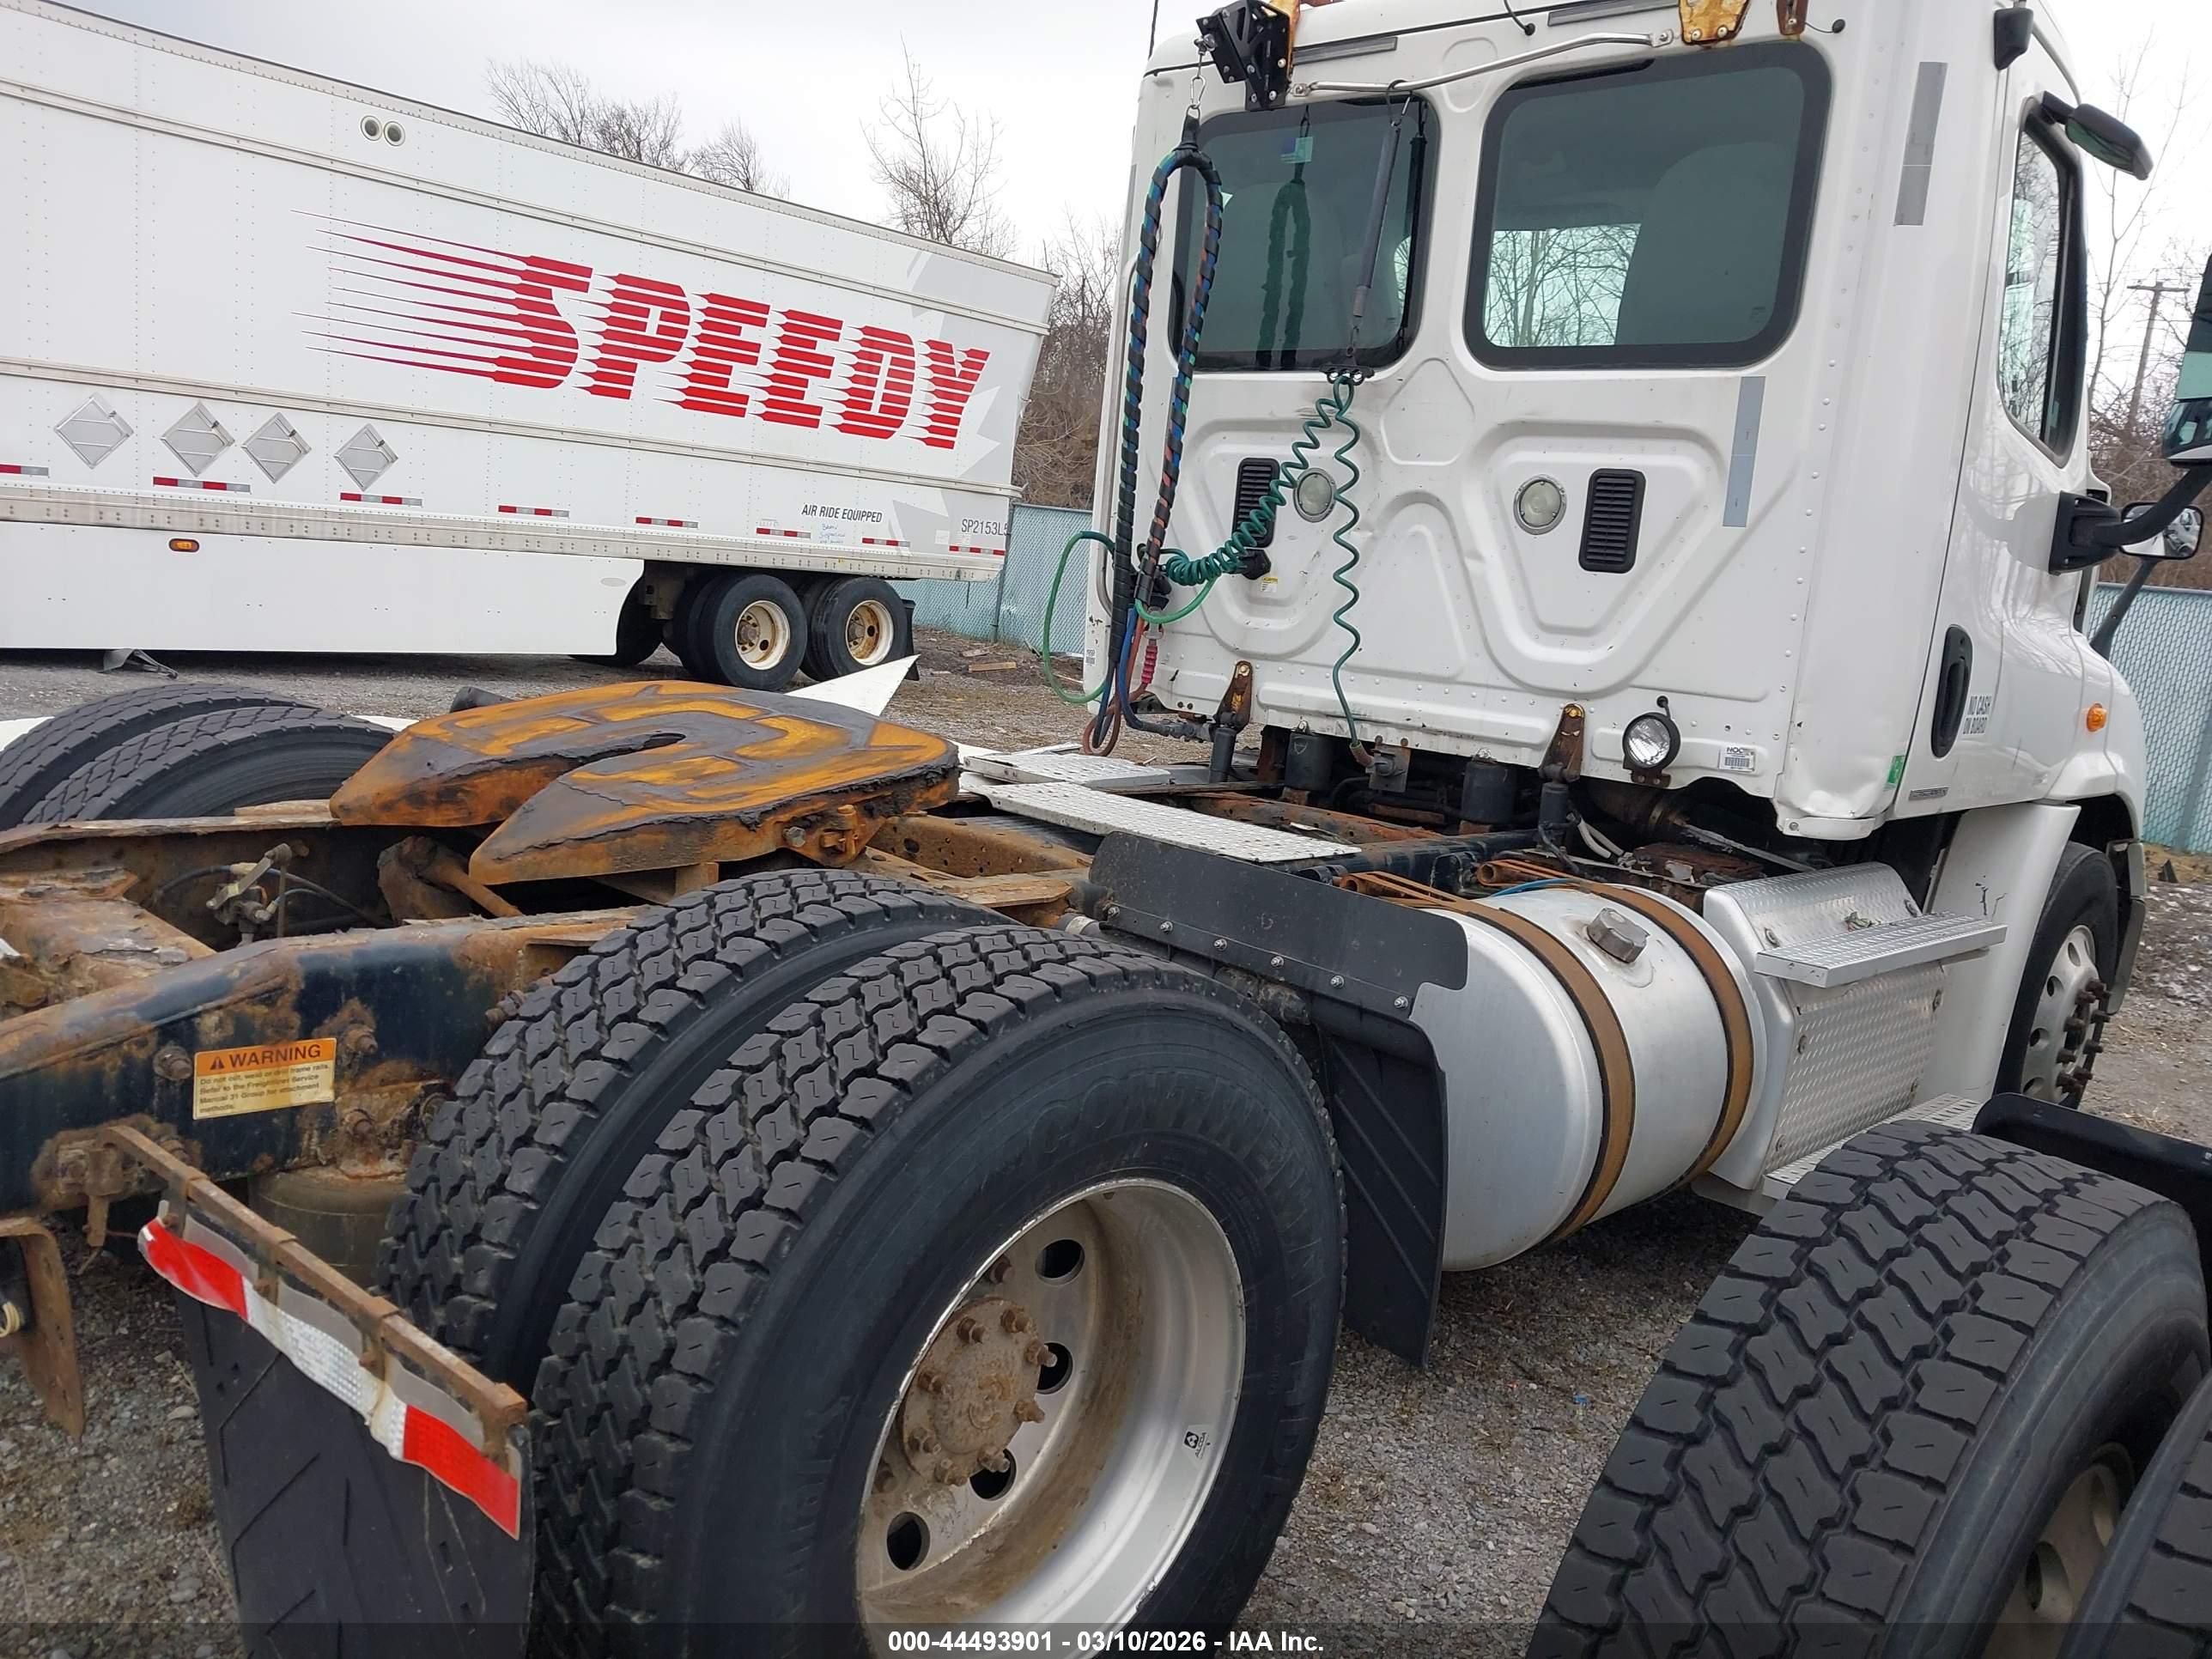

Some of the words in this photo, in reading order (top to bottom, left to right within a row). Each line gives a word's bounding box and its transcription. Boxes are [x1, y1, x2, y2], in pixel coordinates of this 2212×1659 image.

[489, 254, 991, 449] SPEEDY
[801, 504, 817, 516] AIR
[819, 506, 841, 520] RIDE
[842, 508, 883, 523] EQUIPPED
[1967, 696, 1978, 714] NO
[1976, 696, 1992, 714] CASH
[229, 1044, 320, 1067] WARNING
[241, 1090, 264, 1099] Group
